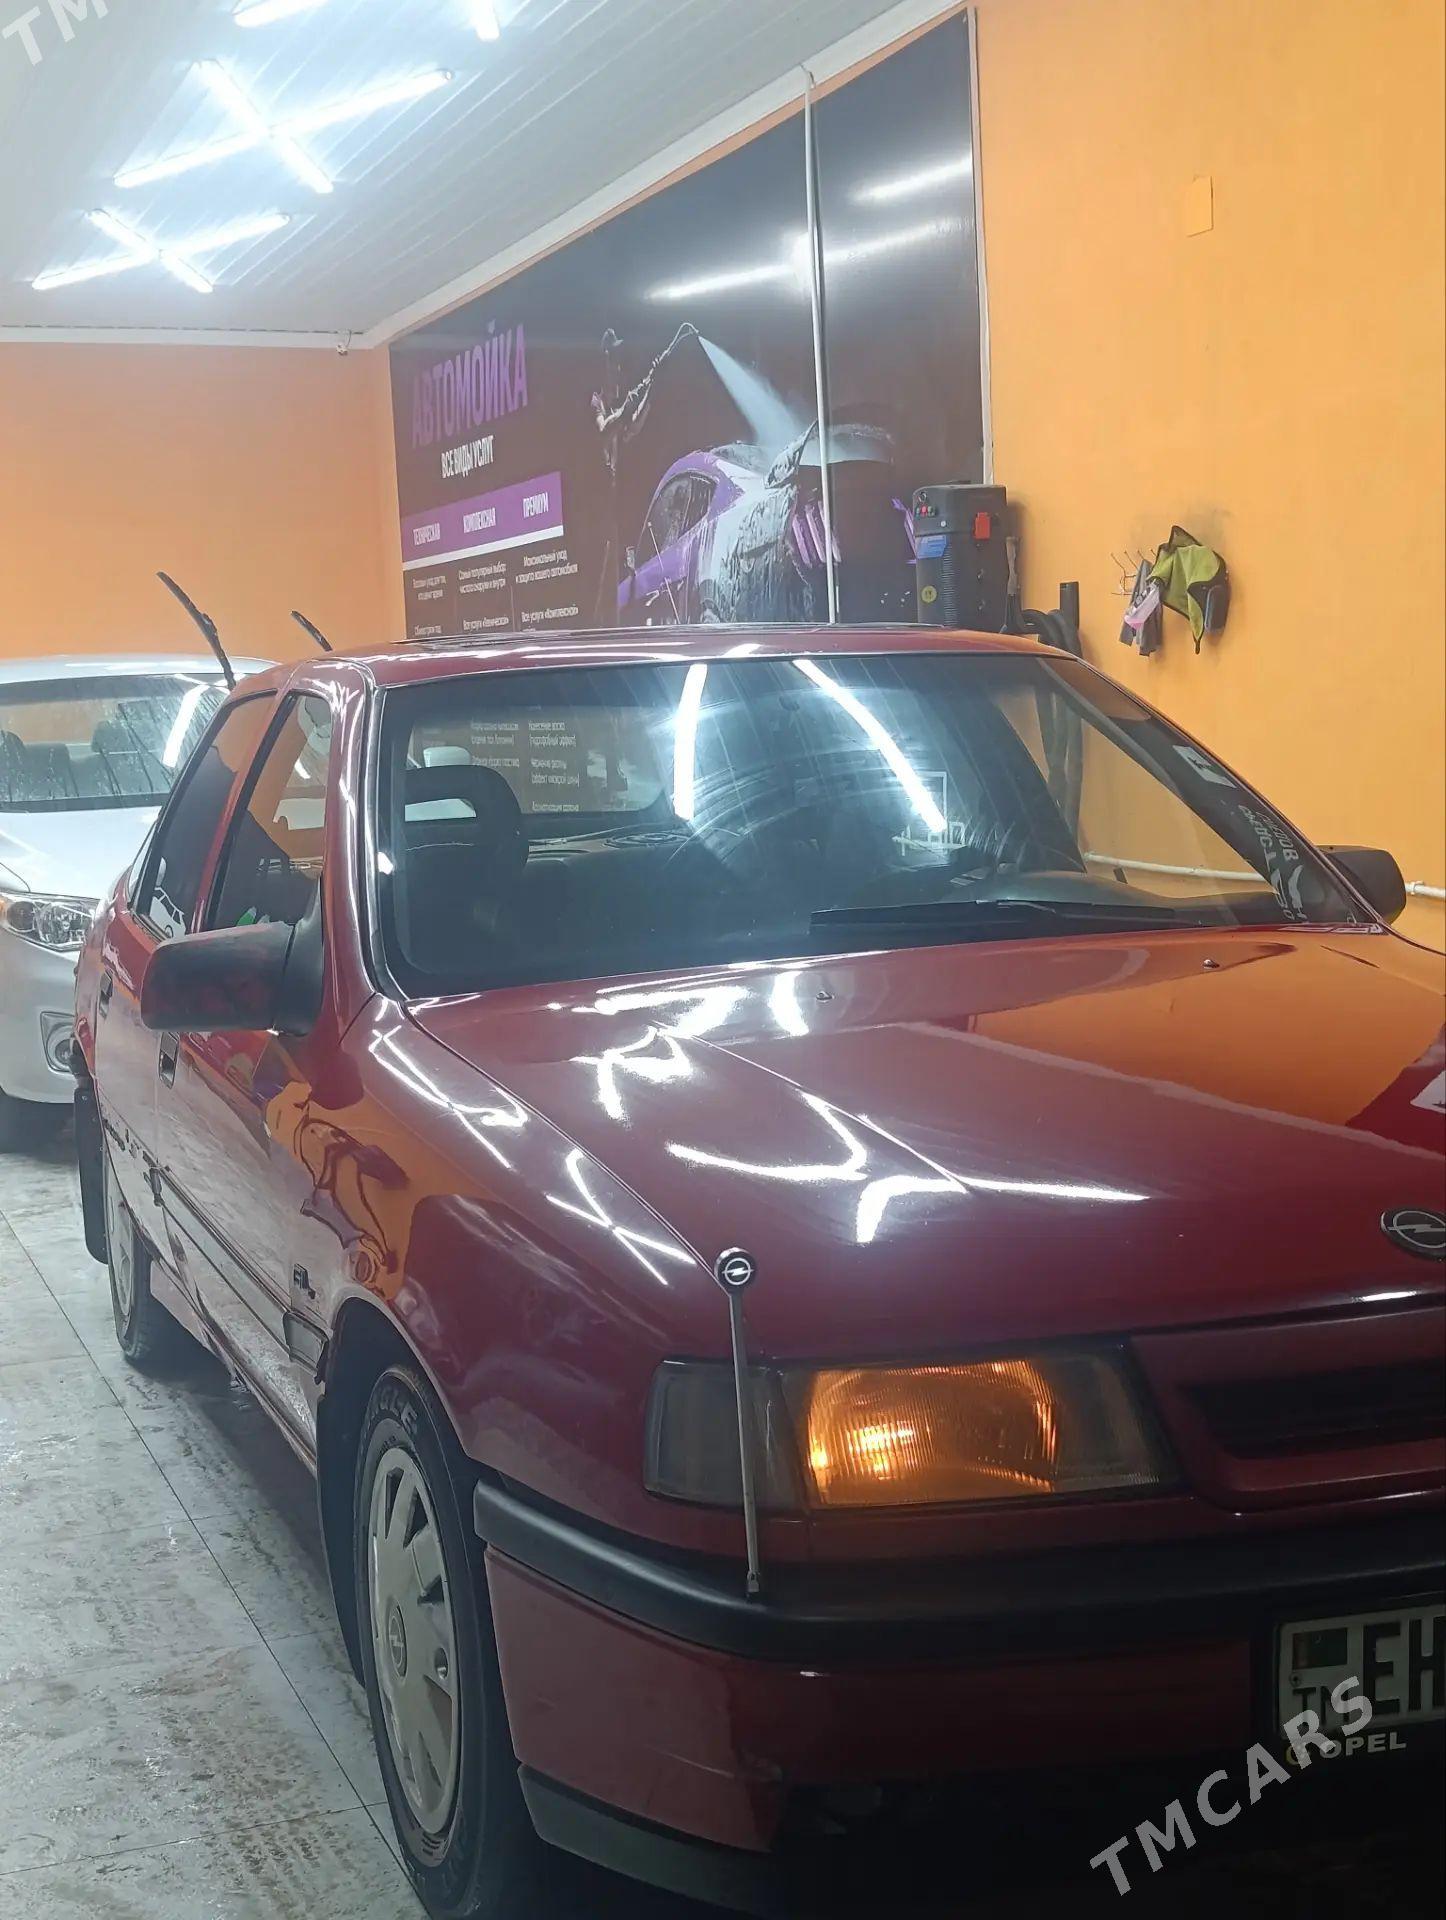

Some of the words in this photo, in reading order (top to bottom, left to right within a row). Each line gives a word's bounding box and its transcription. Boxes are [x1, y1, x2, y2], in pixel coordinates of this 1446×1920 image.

[411, 319, 529, 449] АВТОМОЙКА
[441, 451, 454, 479] ВСЕ
[454, 443, 474, 478] ВИДЫ
[474, 434, 494, 468] УСЛУГ
[522, 492, 549, 519] ПРЕМИУМ
[1319, 1731, 1407, 1758] OPEL
